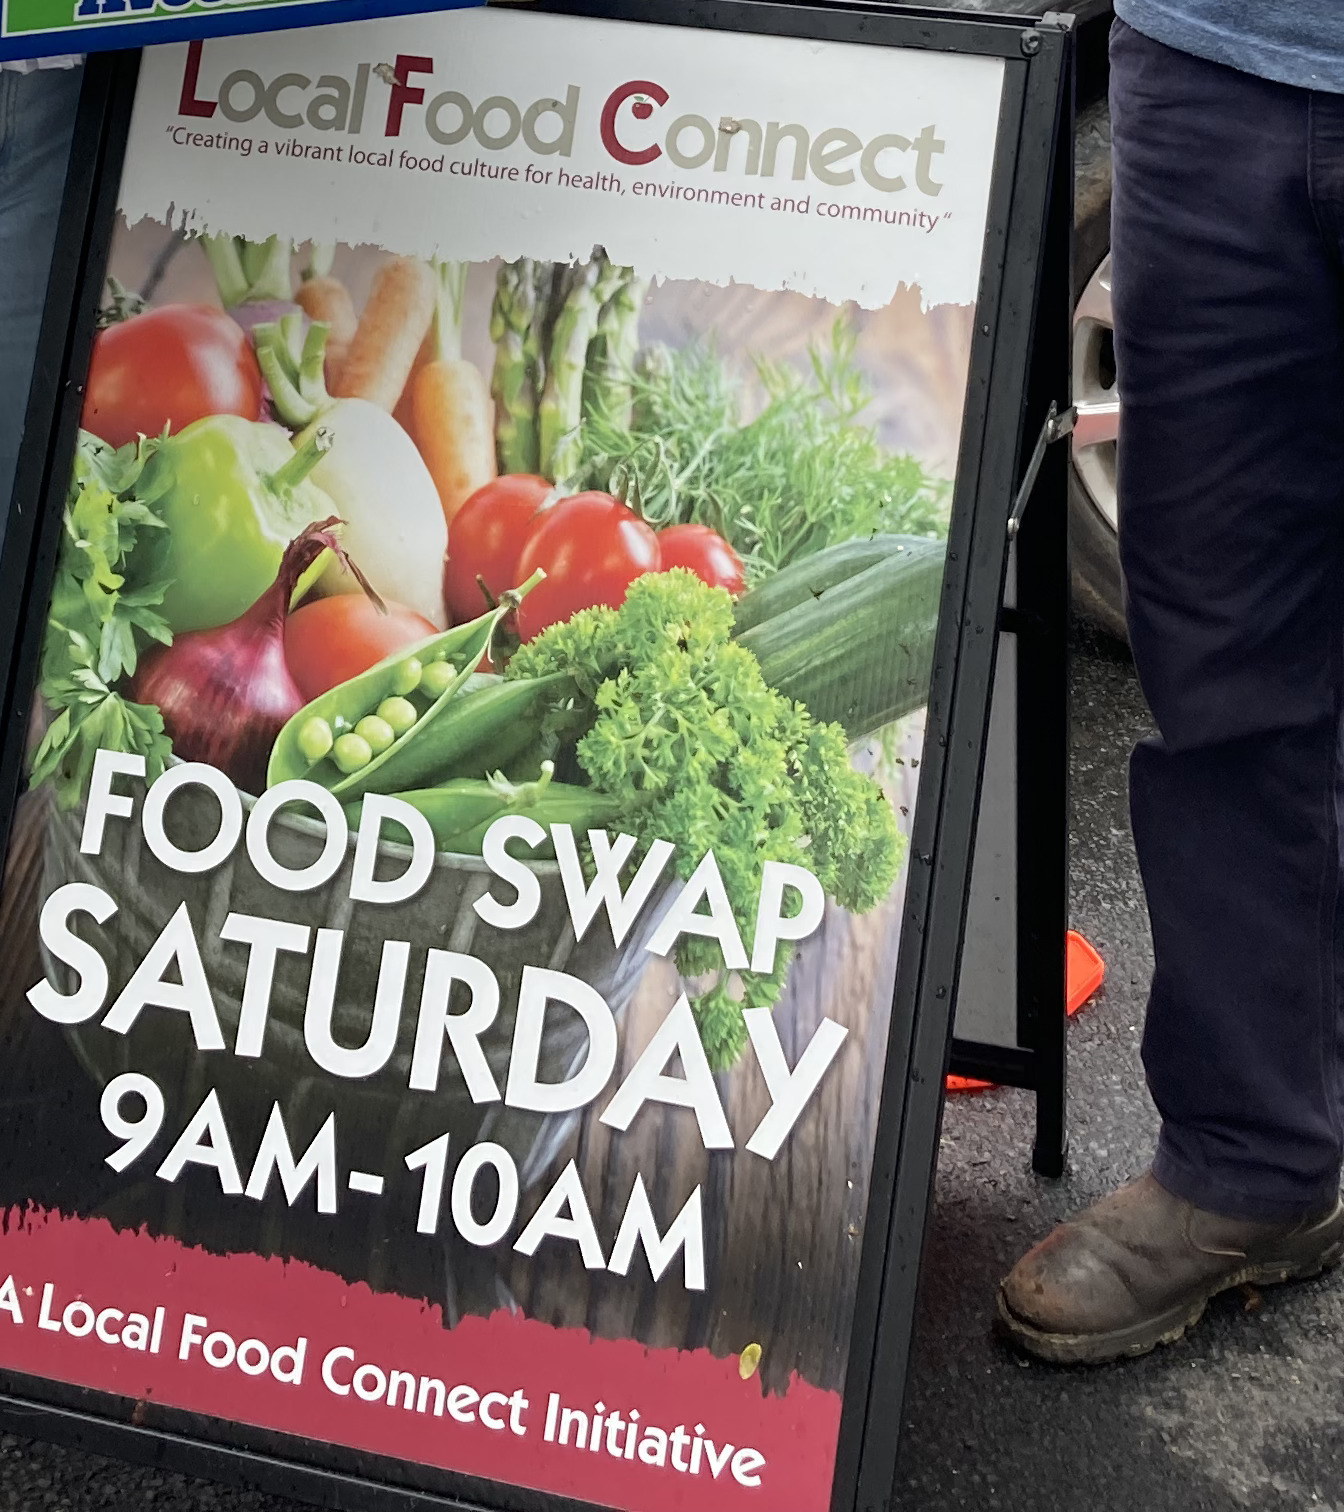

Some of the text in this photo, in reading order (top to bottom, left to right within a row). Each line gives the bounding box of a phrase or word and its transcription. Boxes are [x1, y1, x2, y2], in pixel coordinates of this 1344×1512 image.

[178, 39, 947, 197] Local Food Connect
[258, 140, 269, 155] a
[275, 139, 343, 164] vibrant
[348, 144, 394, 168] local
[398, 149, 445, 174] food
[450, 157, 520, 183] culture
[524, 163, 554, 186] for
[558, 167, 626, 197] health,
[632, 180, 766, 210] environment
[770, 195, 811, 215] and
[78, 748, 826, 975] FOOD SWAP
[25, 882, 849, 1161] SATURDAY
[38, 1282, 166, 1355] Local
[177, 1312, 308, 1386] Food
[321, 1346, 529, 1438] Connect
[543, 1393, 766, 1488] Initiative
